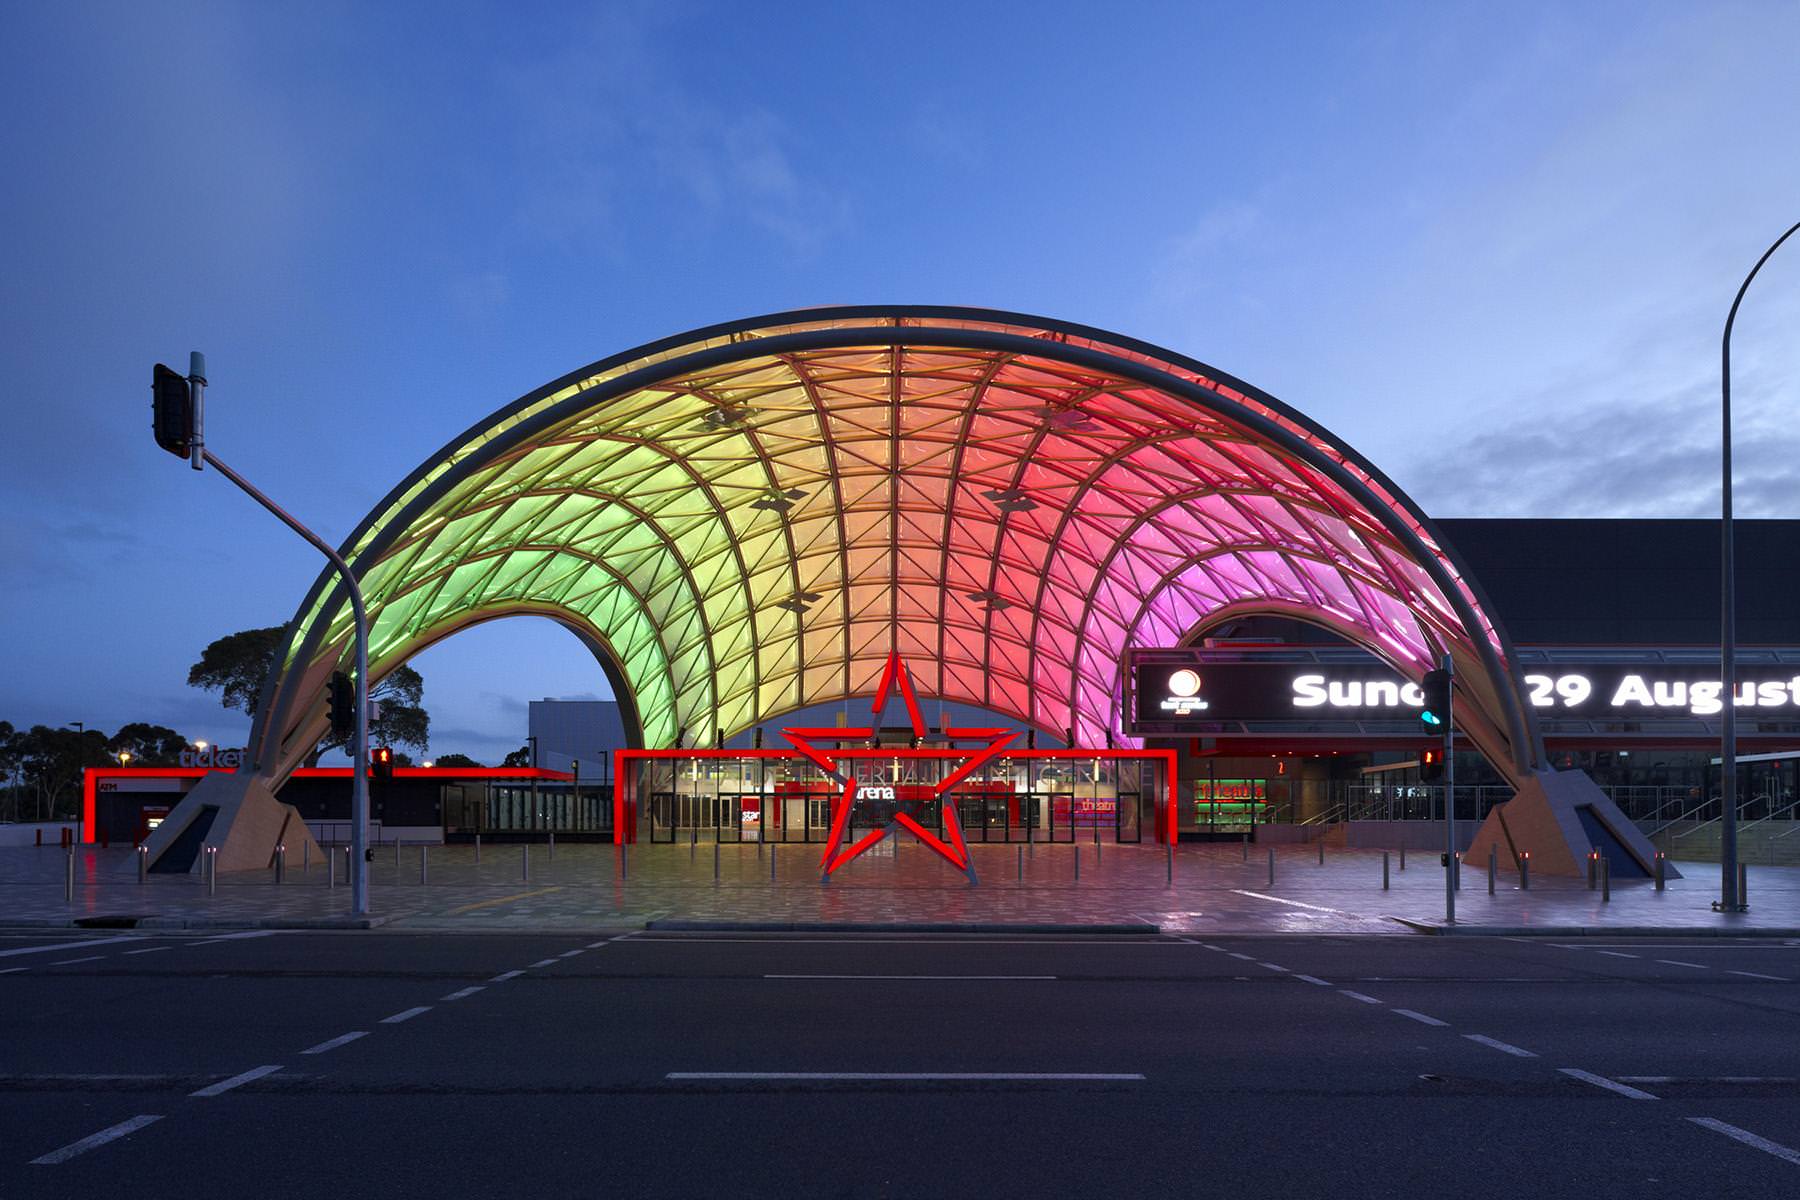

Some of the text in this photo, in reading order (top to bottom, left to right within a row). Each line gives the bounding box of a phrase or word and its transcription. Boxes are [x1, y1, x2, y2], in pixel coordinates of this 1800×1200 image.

[1524, 674, 1592, 707] 29
[1610, 674, 1800, 715] August
[99, 784, 117, 792] ATM
